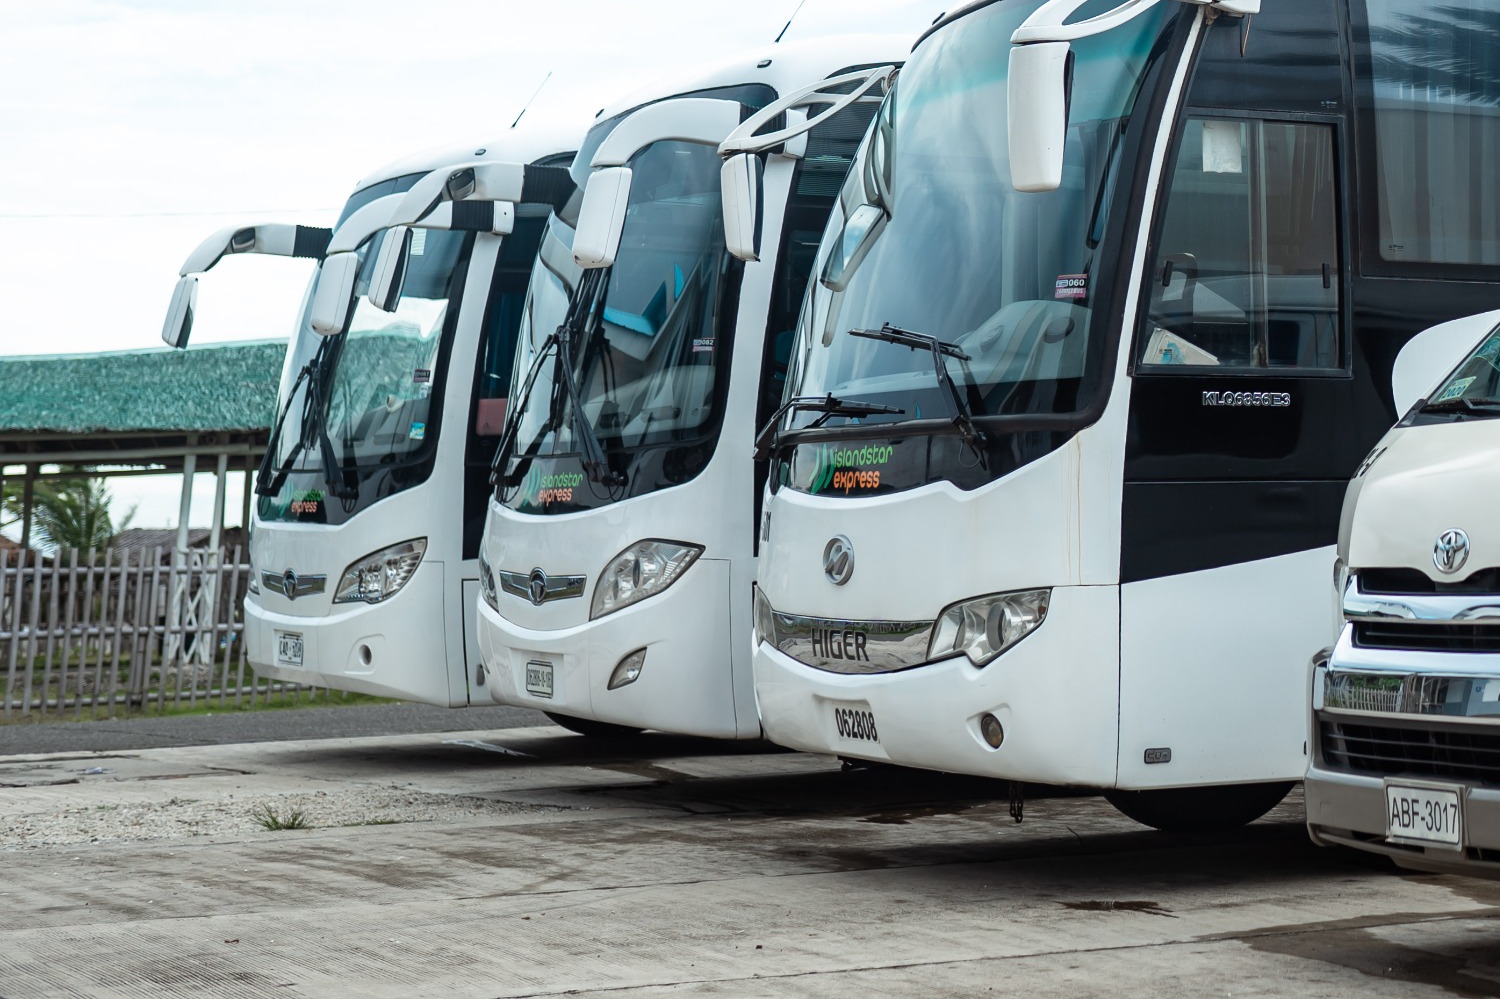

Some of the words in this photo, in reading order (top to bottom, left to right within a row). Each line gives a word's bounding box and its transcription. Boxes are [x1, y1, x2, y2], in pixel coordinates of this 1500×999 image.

[1068, 278, 1085, 287] 060
[1202, 390, 1291, 407] KLQ6856E3
[834, 444, 893, 468] islandstar
[540, 471, 583, 489] islandstar
[833, 470, 881, 496] express
[538, 487, 573, 506] express
[291, 500, 318, 517] express
[811, 627, 870, 662] HIGER
[835, 707, 878, 742] 062808
[1391, 797, 1458, 835] ABF-3017
